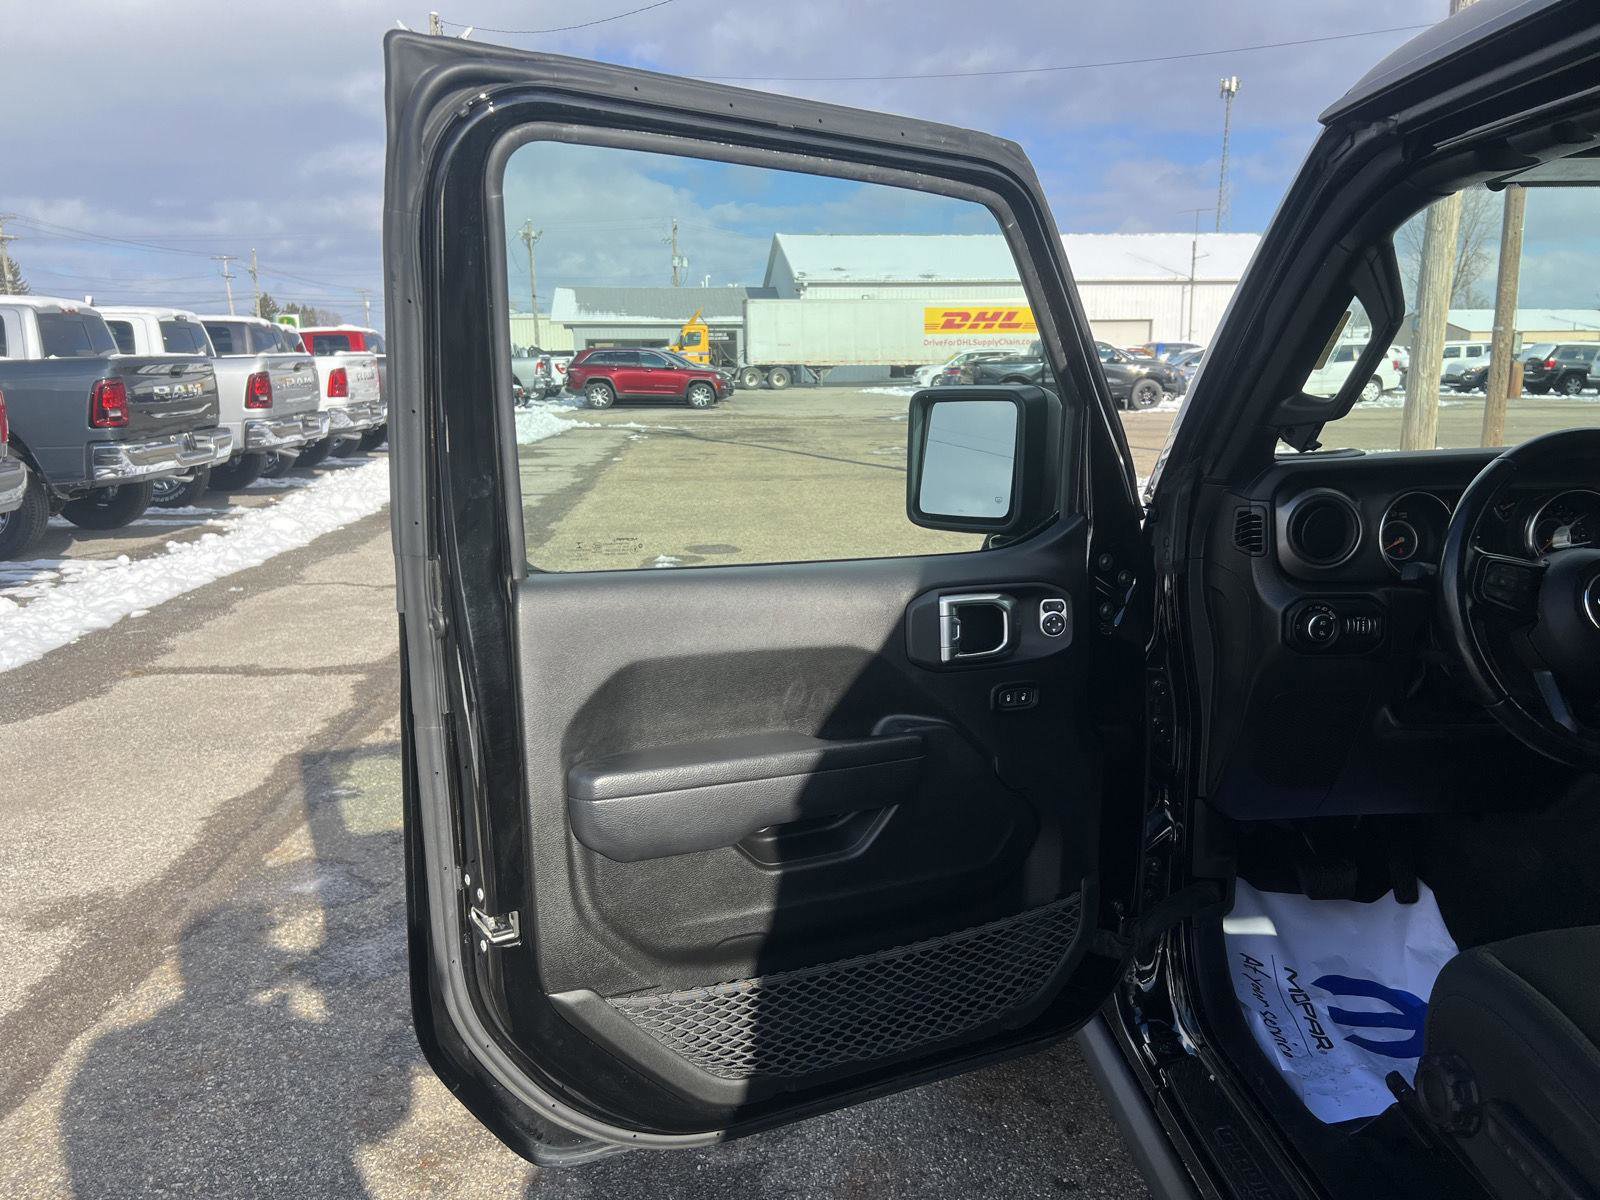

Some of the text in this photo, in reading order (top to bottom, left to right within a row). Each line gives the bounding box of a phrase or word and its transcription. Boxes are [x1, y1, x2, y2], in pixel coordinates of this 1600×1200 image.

[940, 311, 1023, 330] DHL
[153, 383, 204, 400] RAM
[284, 376, 313, 390] RAM
[1240, 953, 1271, 979] At
[1284, 966, 1334, 1050] MOPAR
